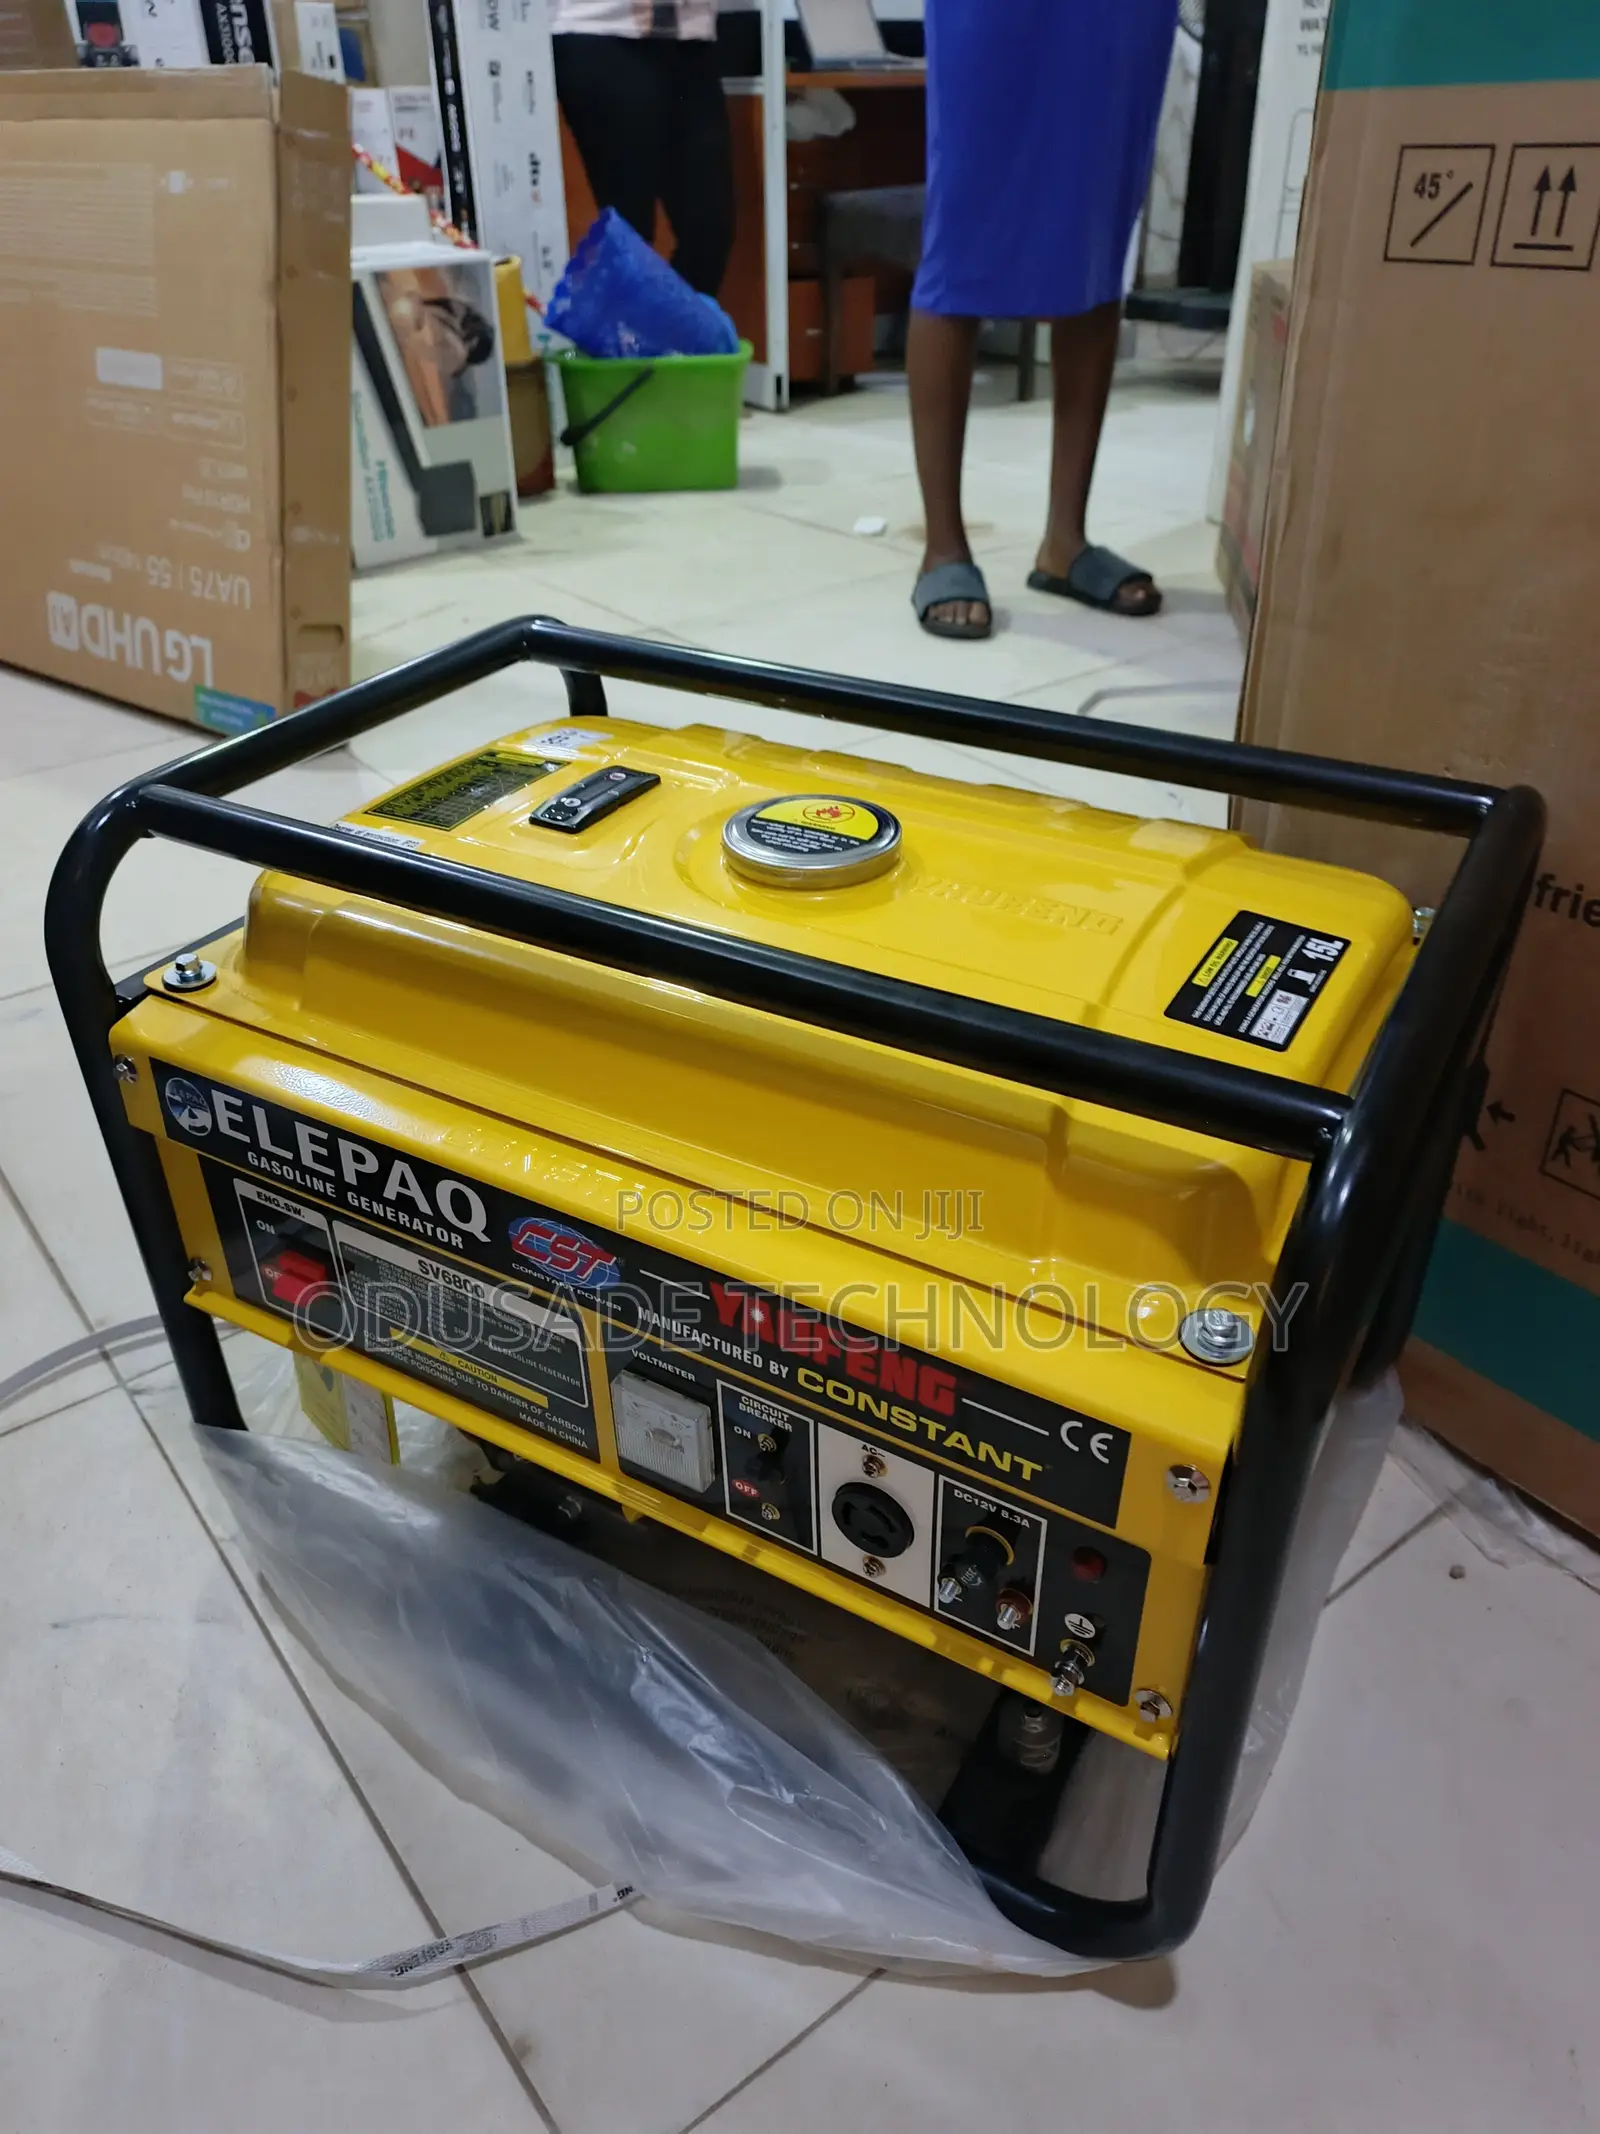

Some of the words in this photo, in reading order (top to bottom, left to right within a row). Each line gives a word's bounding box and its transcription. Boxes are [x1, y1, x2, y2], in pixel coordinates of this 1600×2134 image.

[147, 555, 172, 588] 55
[190, 566, 251, 610] UA75
[165, 629, 214, 690] LG
[1302, 937, 1344, 962] 15L
[211, 1089, 491, 1242] ELEPAQ
[247, 1151, 337, 1198] GASOLINE
[347, 1191, 464, 1249] GENERATOR
[256, 1190, 305, 1218] ENG.SW.
[256, 1219, 275, 1235] ON
[511, 1223, 617, 1279] CST
[418, 1259, 485, 1299] SV6800
[511, 1262, 575, 1292] CONSTANT
[577, 1289, 622, 1311] POWER
[457, 1360, 498, 1383] CAUTION
[631, 1348, 696, 1382] VOLTMETER
[456, 1371, 475, 1385] DUE
[476, 1380, 489, 1392] TO
[490, 1387, 529, 1410] DANGER
[530, 1404, 543, 1416] OF
[545, 1411, 586, 1436] CARBON
[638, 1306, 763, 1368] MANUFACTURED
[769, 1359, 789, 1379] BY
[797, 1367, 1043, 1481] CONSTANT
[741, 1395, 790, 1422] CIRCUIT
[519, 1411, 545, 1430] MADE
[547, 1423, 557, 1435] IN
[558, 1430, 589, 1449] CHINA
[733, 1425, 751, 1440] ON
[738, 1403, 793, 1433] BREAKER
[1060, 1420, 1114, 1464] CE
[735, 1481, 758, 1497] OFF
[953, 1488, 997, 1513] DC12V
[1000, 1509, 1031, 1529] 8.3A
